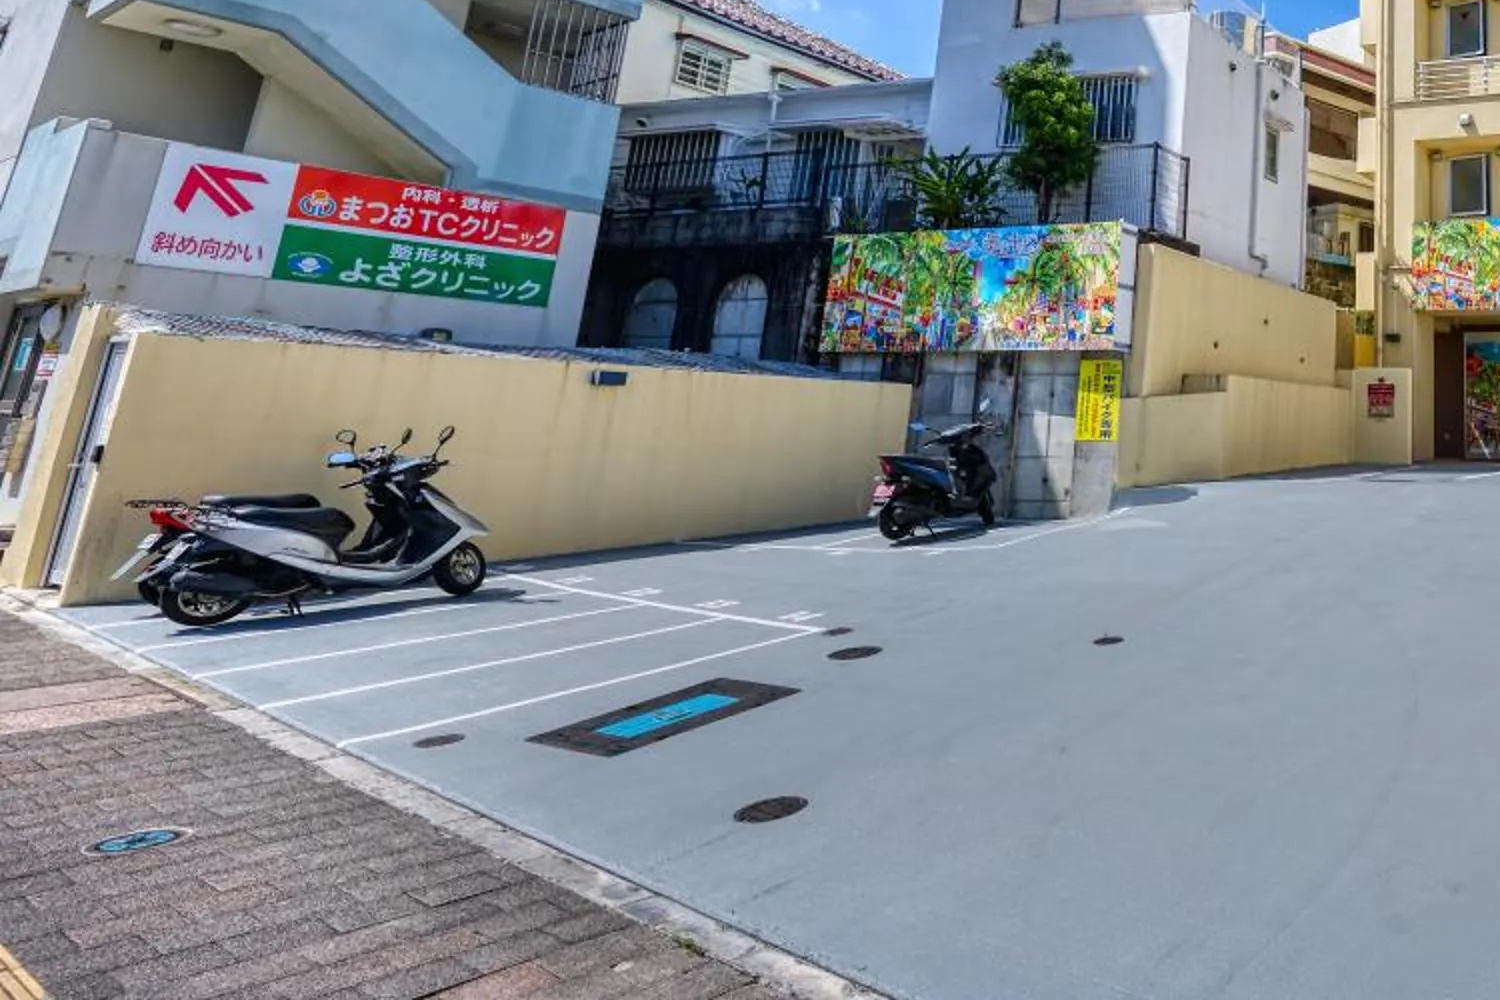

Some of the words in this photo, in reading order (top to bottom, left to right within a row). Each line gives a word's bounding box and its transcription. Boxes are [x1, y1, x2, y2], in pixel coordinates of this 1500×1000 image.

[150, 231, 264, 263] 斜め向かい
[387, 243, 488, 270] 整形外科
[338, 256, 542, 301] よざクリニック
